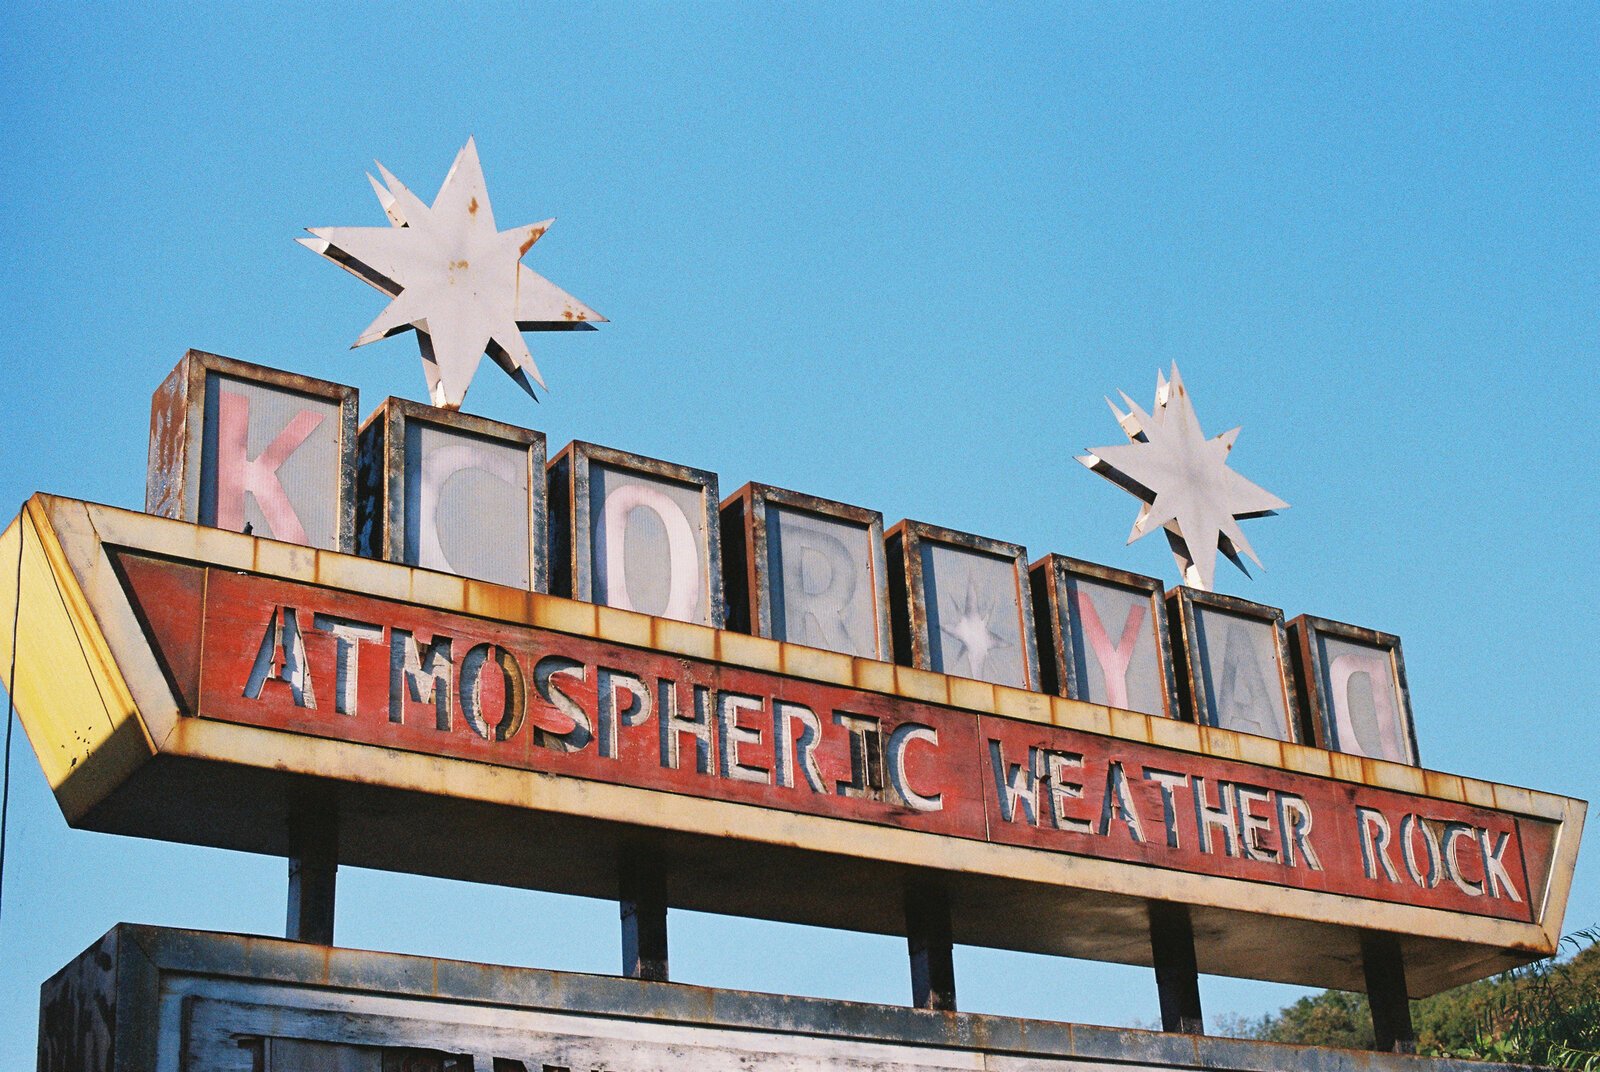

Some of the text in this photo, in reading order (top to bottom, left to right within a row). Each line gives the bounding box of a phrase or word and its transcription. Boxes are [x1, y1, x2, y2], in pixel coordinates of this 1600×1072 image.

[242, 604, 1523, 903] ATMOSPHERIC WEATHER ROCK
